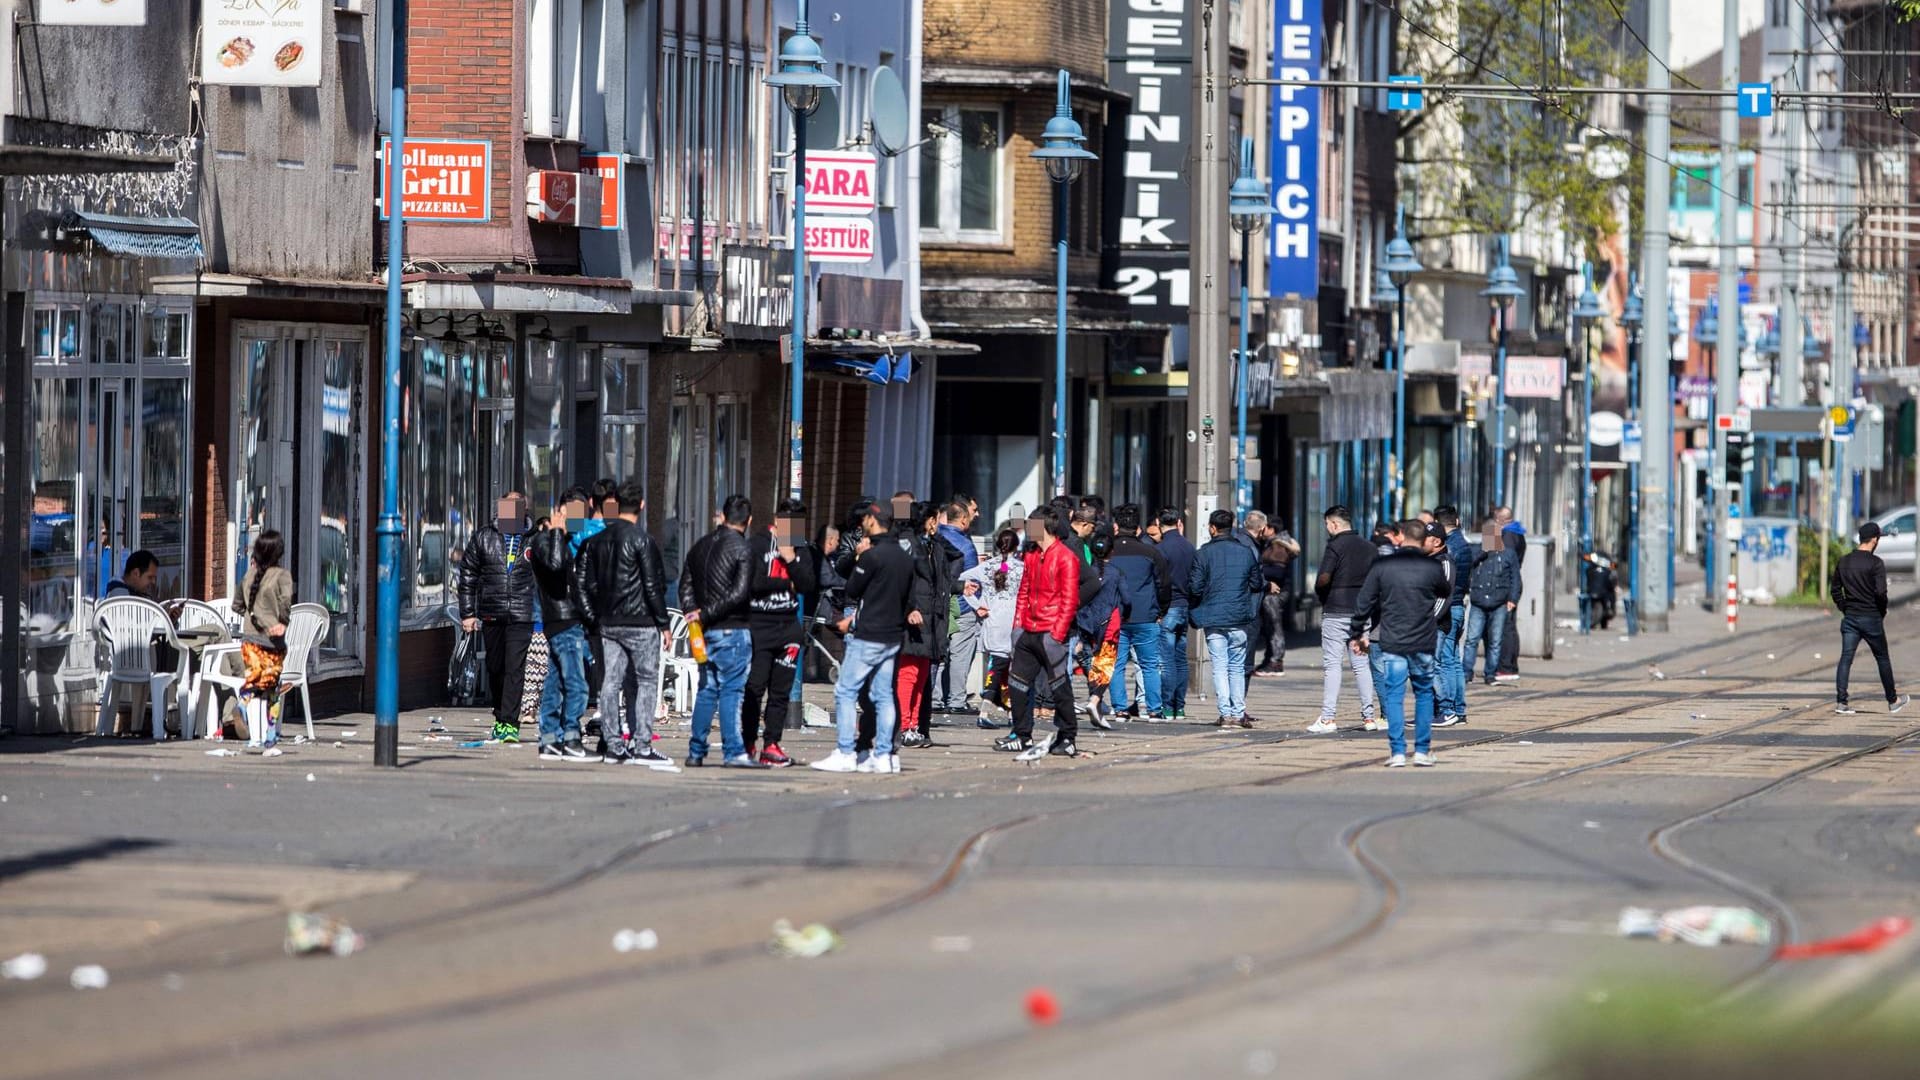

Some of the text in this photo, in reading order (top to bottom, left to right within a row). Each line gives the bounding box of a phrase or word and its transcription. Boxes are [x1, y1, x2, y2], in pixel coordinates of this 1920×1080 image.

[1741, 87, 1767, 113] T
[401, 167, 472, 196] Grill
[401, 200, 467, 213] PIZZERIA
[803, 224, 870, 250] ESETTÜR
[1114, 267, 1190, 306] 21
